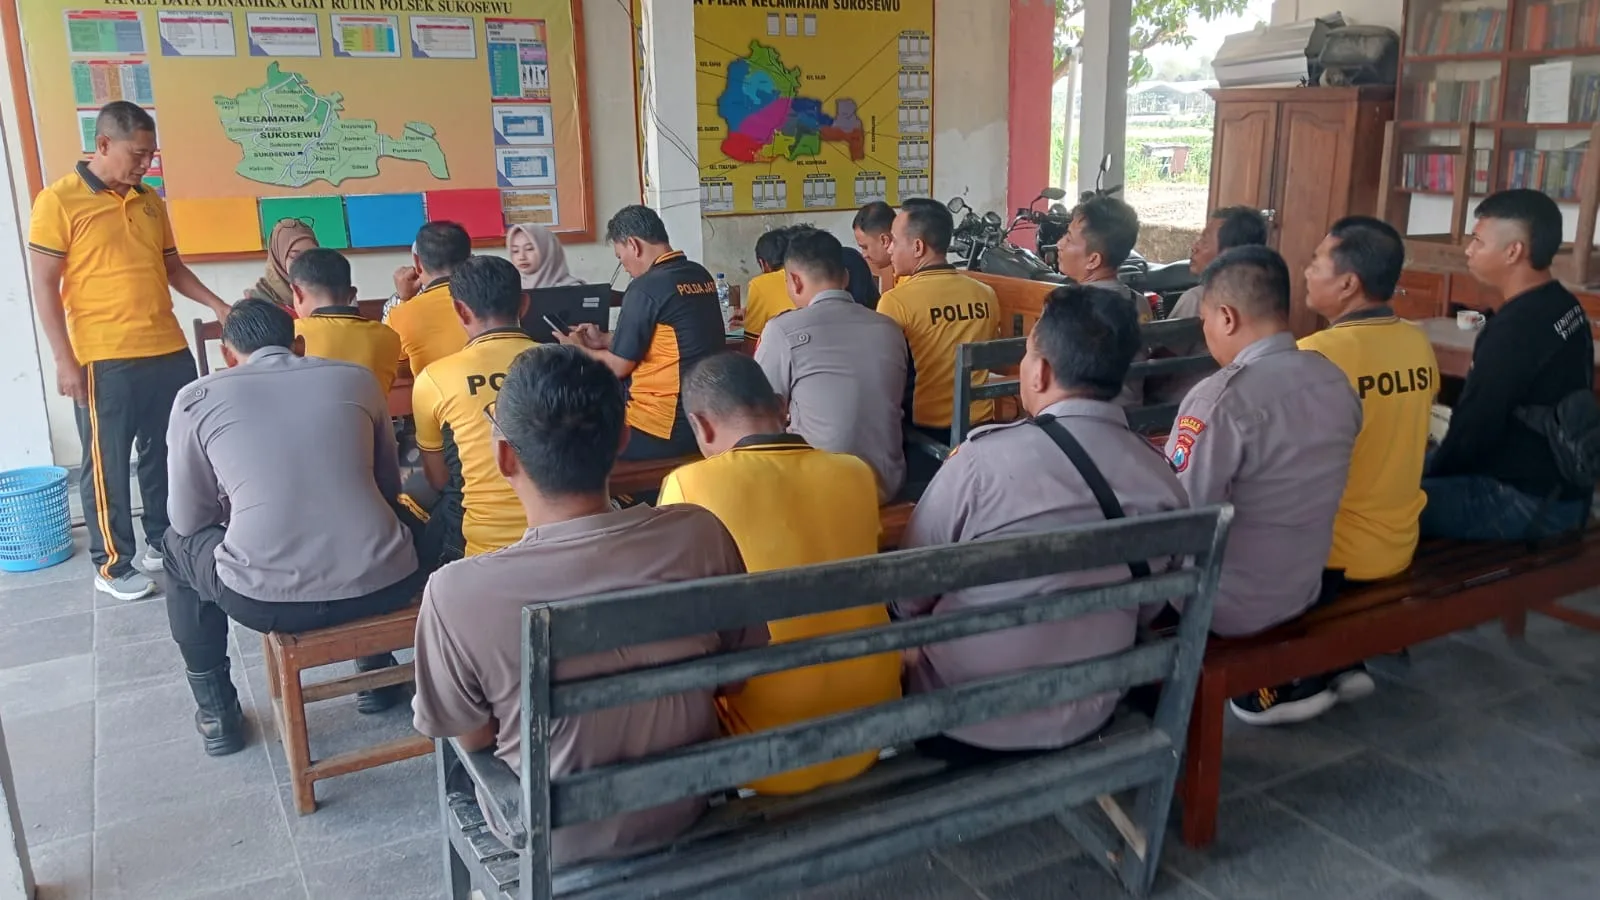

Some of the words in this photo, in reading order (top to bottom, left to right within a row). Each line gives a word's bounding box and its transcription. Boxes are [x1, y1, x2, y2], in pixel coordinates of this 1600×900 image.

[332, 0, 376, 9] RUTIN
[380, 0, 436, 11] POLSEK
[439, 0, 512, 13] SUKOSEWU
[751, 0, 828, 9] KECAMATAN
[833, 0, 900, 12] SUKOSEWU
[676, 282, 705, 296] POLDA
[930, 302, 989, 325] POLISI
[1357, 366, 1432, 399] POLISI
